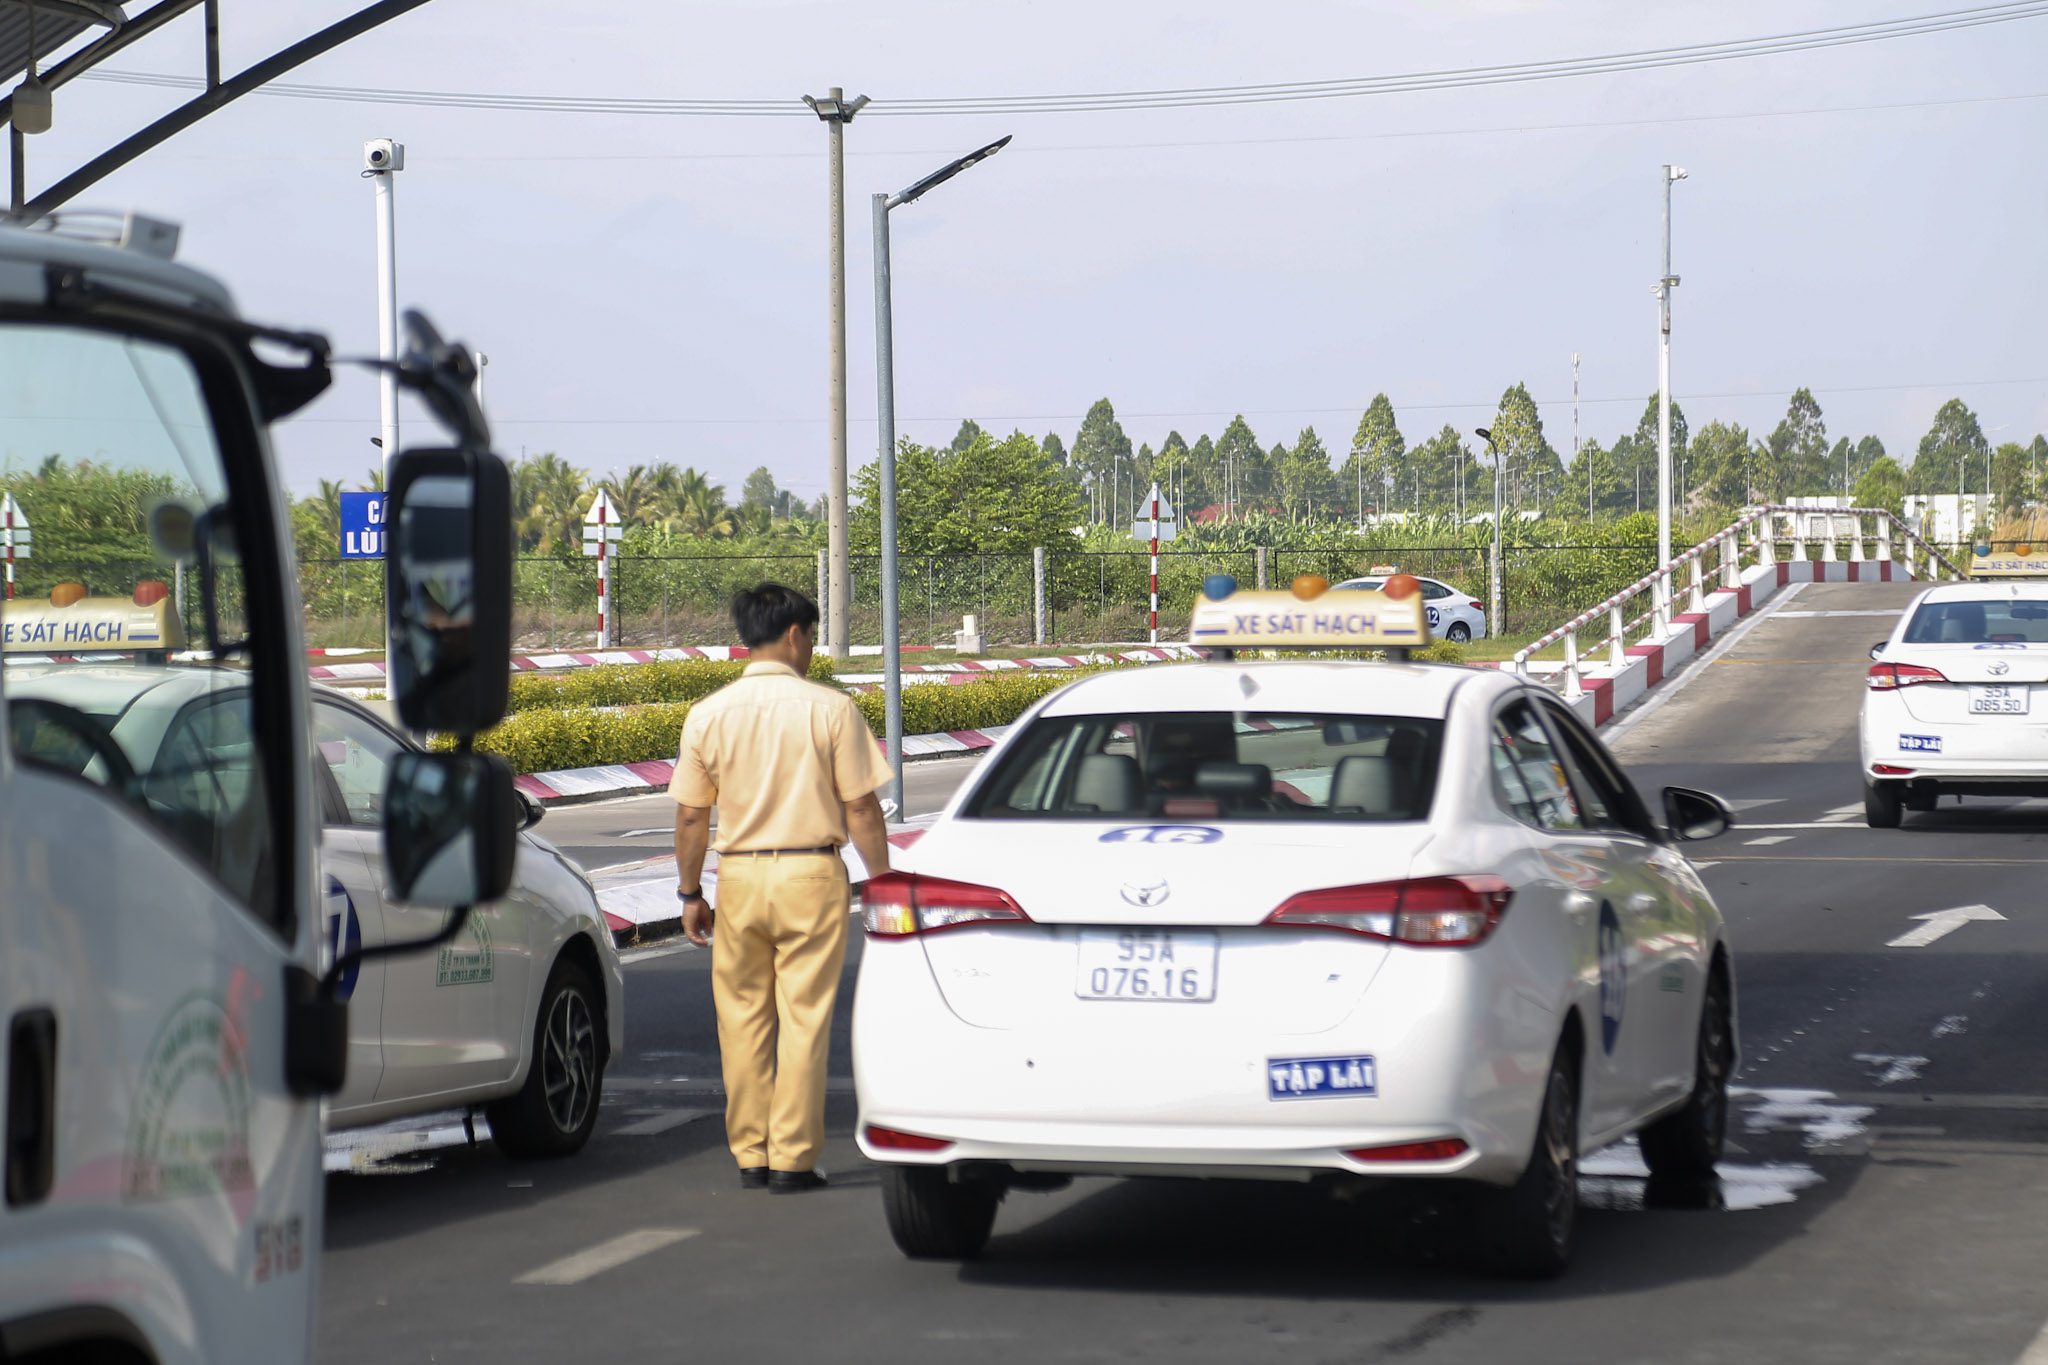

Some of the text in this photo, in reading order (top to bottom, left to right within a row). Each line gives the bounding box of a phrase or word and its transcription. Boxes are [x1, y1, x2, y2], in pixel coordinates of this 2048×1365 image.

[0, 617, 122, 644] E SÁT HẠCH
[1234, 609, 1376, 636] XE SÁT HẠCH
[1426, 609, 1440, 624] 12
[1118, 933, 1175, 963] 95A
[1091, 967, 1199, 998] 076.16
[1271, 1060, 1374, 1095] TẬP LÁI
